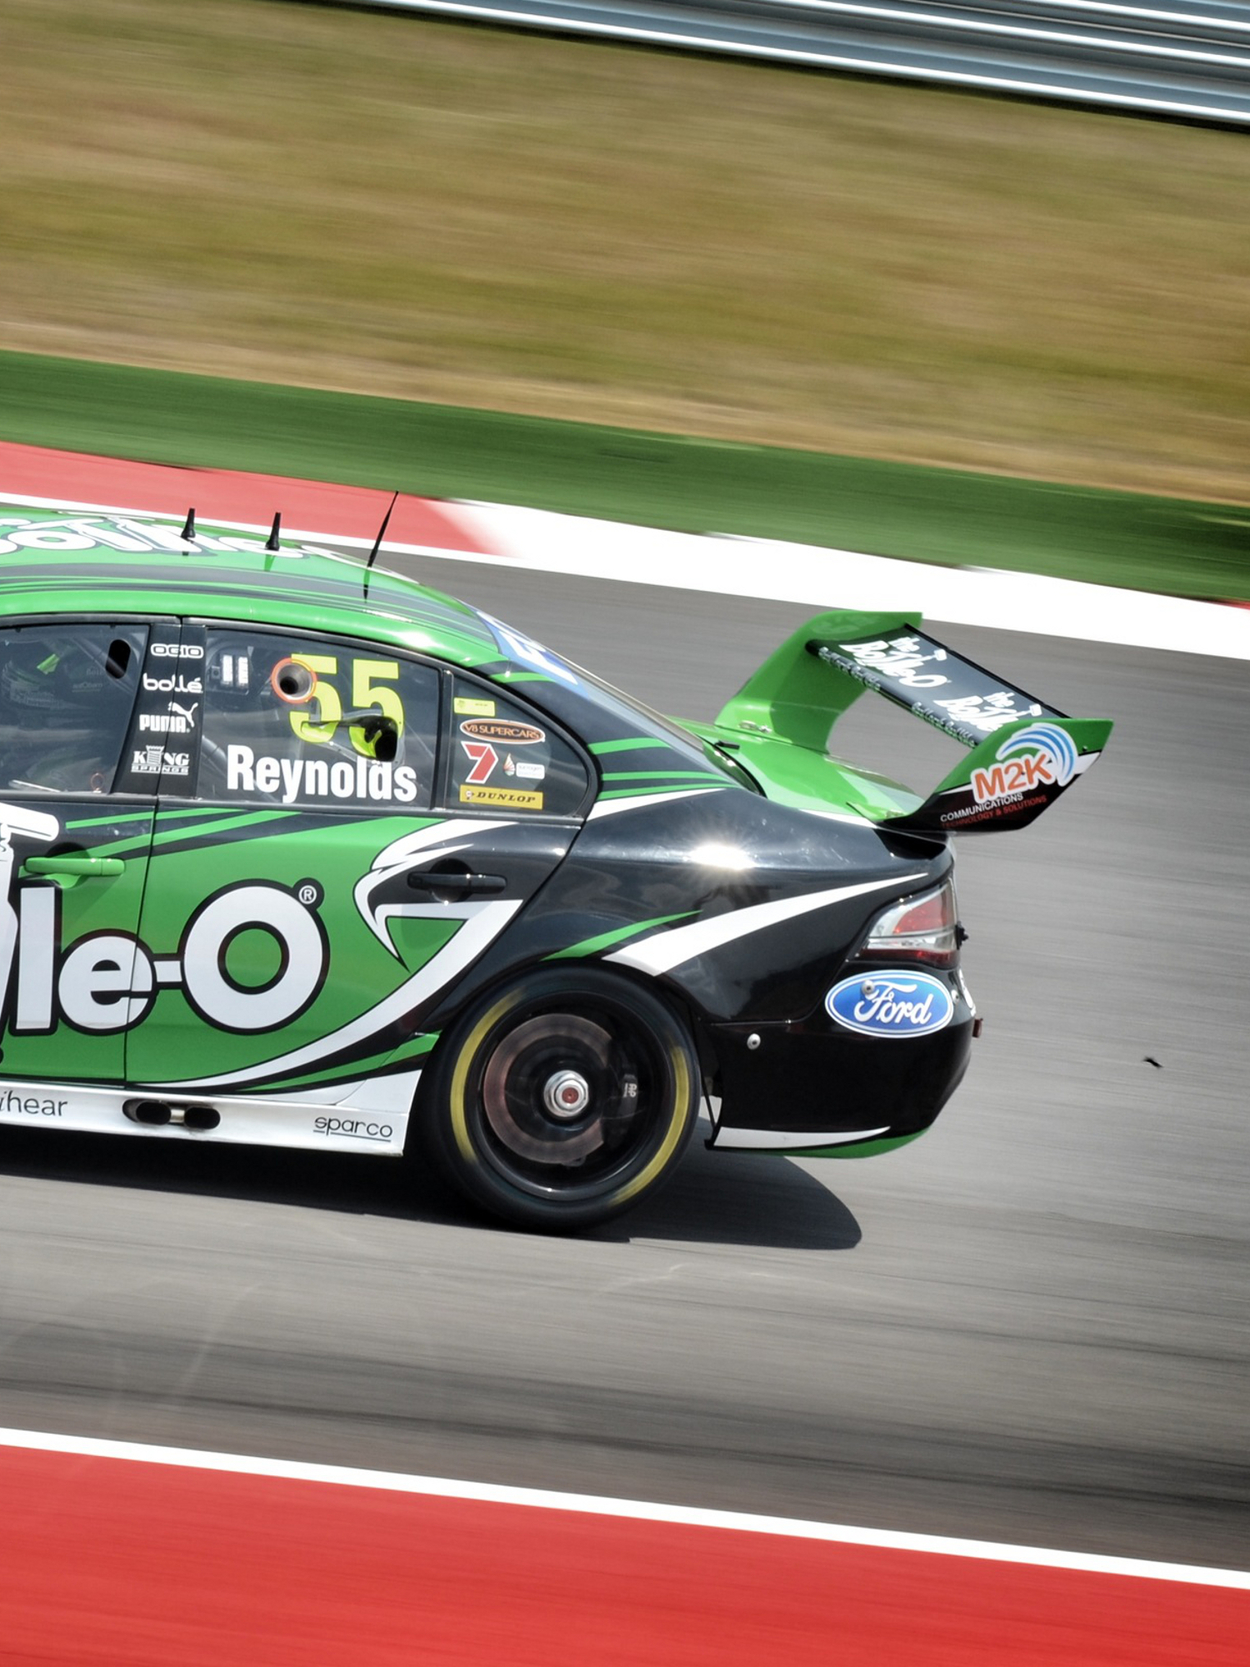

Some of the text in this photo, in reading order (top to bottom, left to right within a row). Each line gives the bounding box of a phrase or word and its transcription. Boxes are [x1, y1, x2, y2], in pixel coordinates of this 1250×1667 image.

[150, 643, 204, 659] OGIO
[143, 672, 203, 693] bollé
[289, 653, 405, 760] 55
[933, 695, 1042, 732] Bottle
[139, 714, 187, 733] PUMA
[463, 723, 540, 739] V8 SUPERCARS
[227, 744, 417, 803] Reynolds
[974, 753, 1052, 800] M2K
[476, 791, 536, 803] DUNLOP
[940, 792, 1024, 822] COMMUNICATIONS
[854, 980, 934, 1025] Ford
[313, 1115, 393, 1140] sparco
